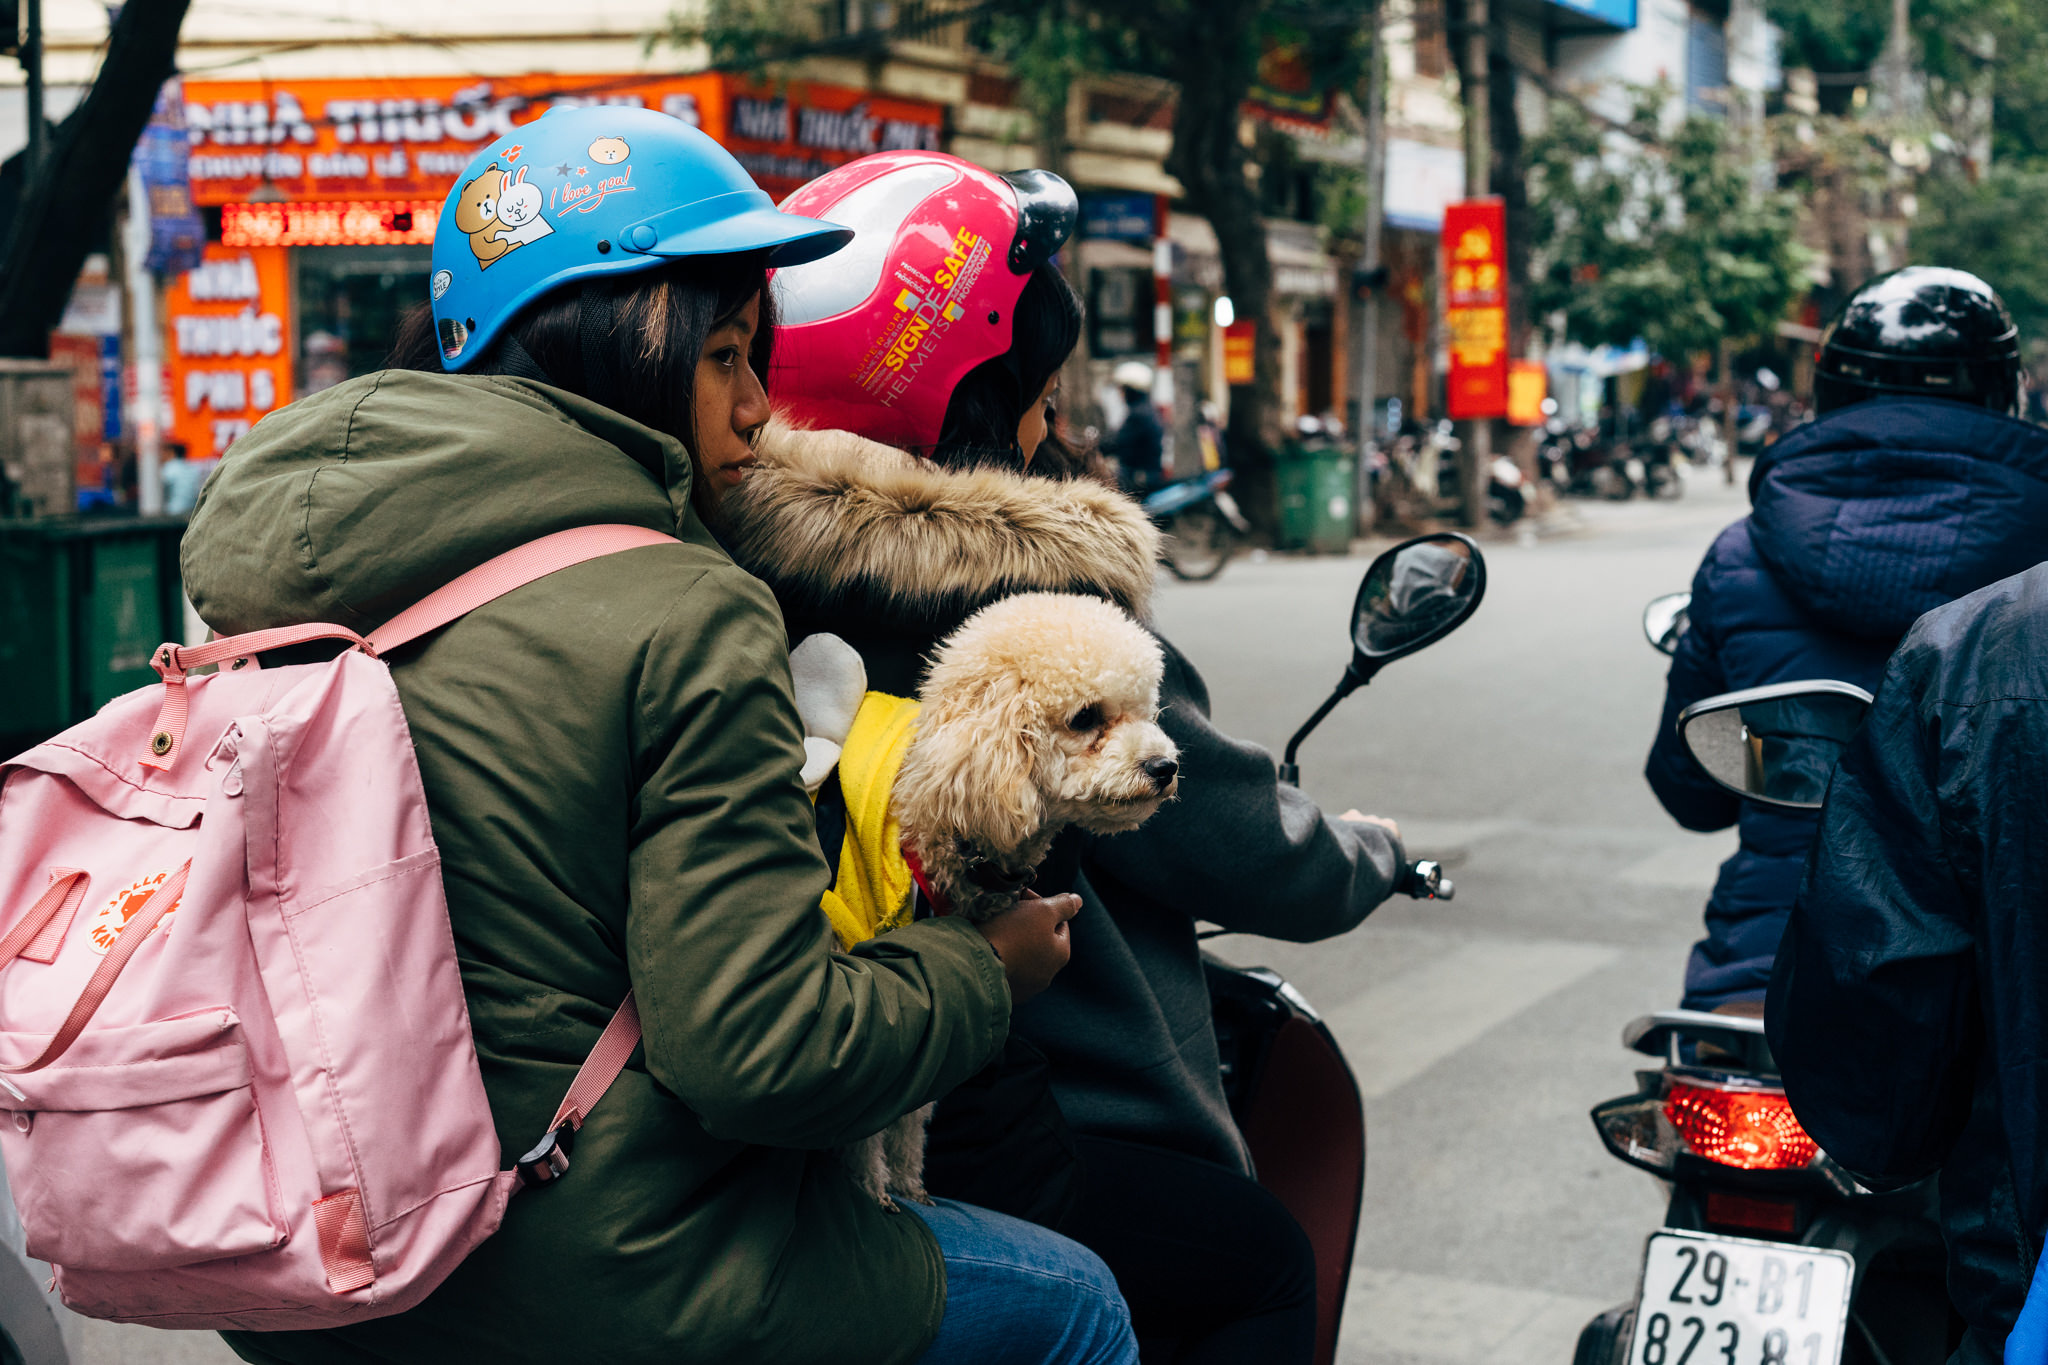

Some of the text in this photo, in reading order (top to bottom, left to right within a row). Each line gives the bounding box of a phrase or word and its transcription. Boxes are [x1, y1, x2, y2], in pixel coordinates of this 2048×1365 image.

[562, 182, 593, 203] love
[934, 226, 978, 290] SAFE
[957, 256, 988, 305] PROTECTION
[849, 312, 902, 380] SUPERIOR
[880, 318, 950, 408] HELMETS
